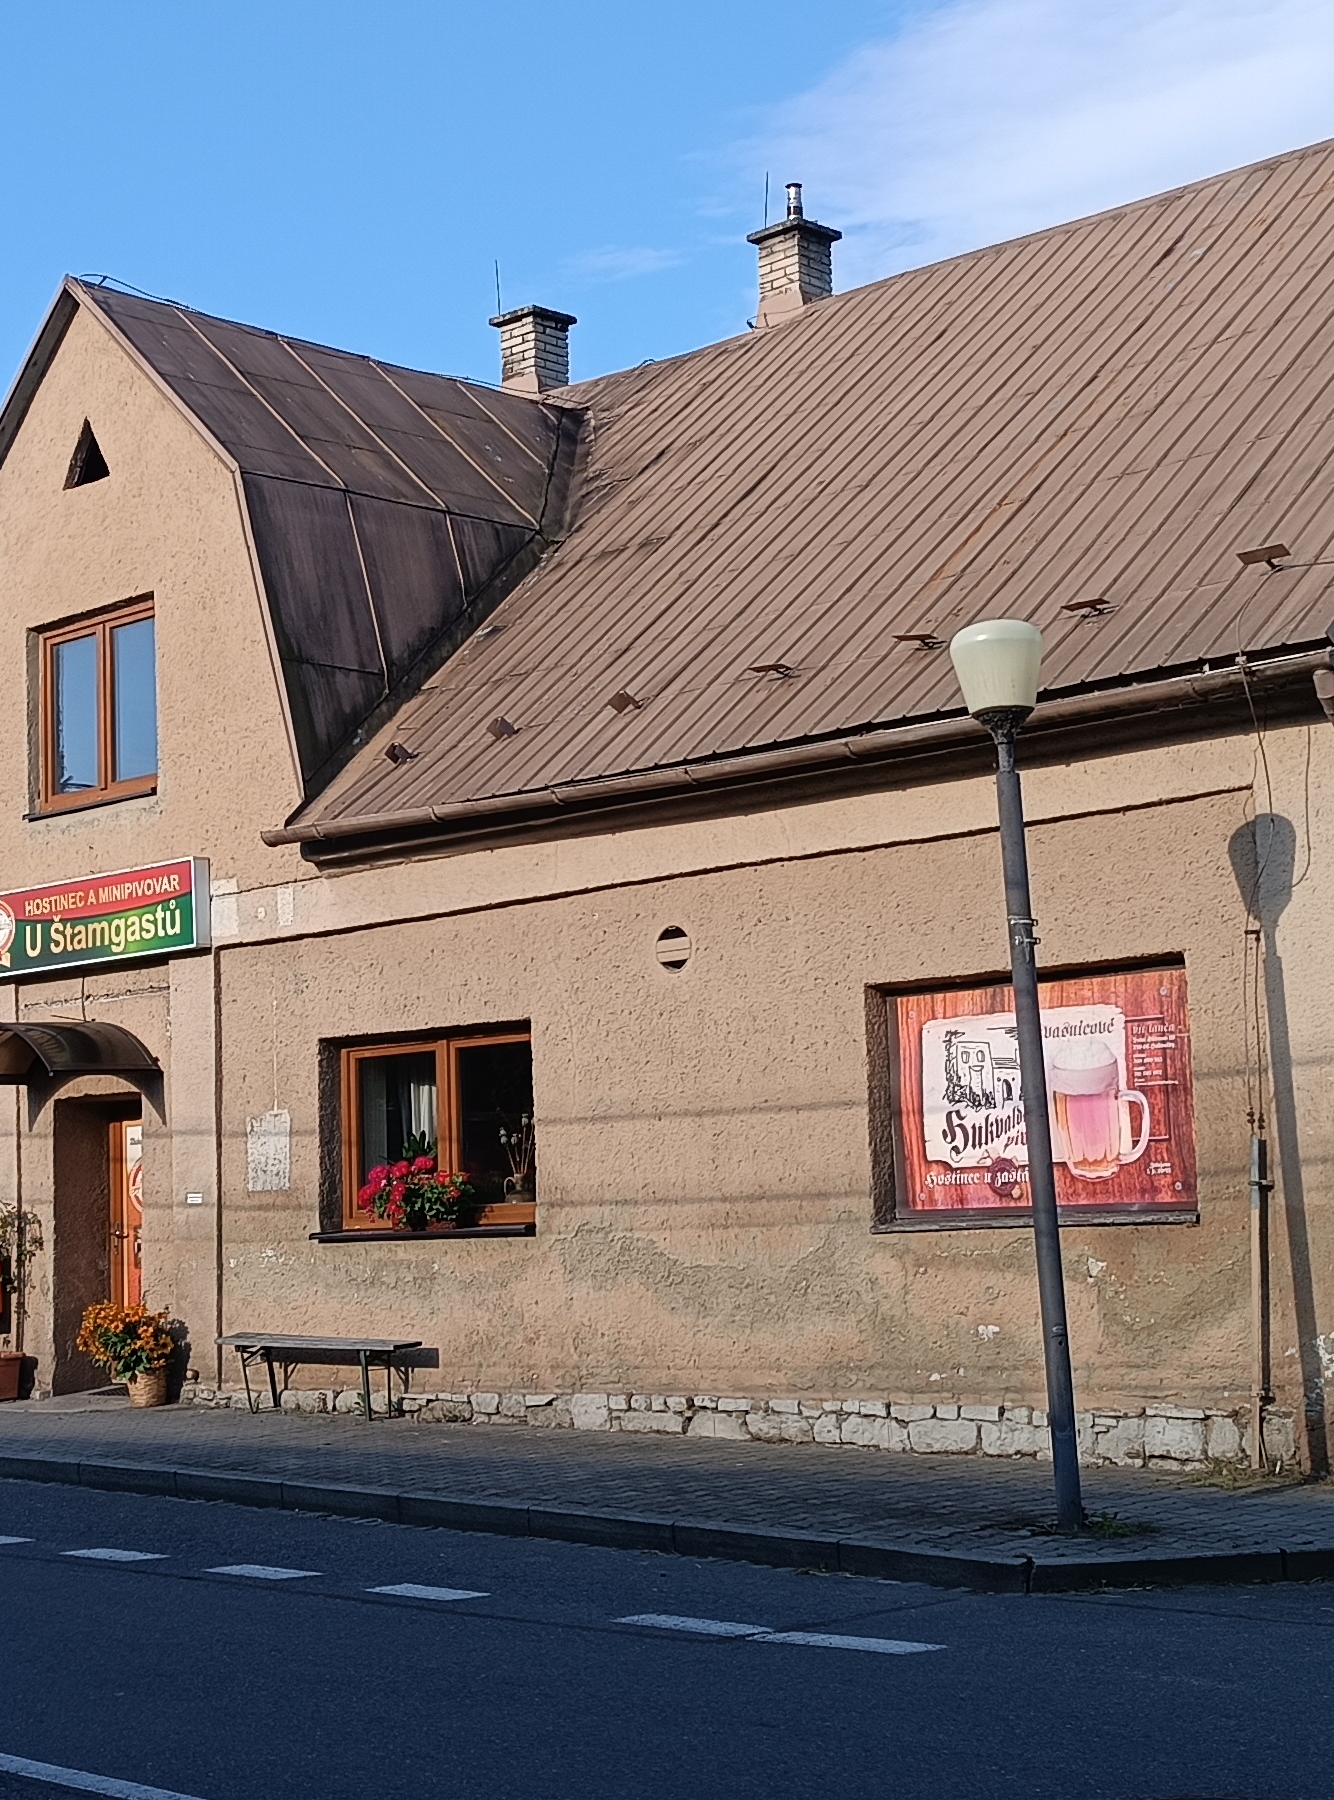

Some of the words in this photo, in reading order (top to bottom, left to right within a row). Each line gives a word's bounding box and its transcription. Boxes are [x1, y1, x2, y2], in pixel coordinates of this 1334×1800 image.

[24, 891, 85, 917] HOSTINEC
[87, 889, 97, 906] A
[98, 874, 180, 904] MINIPIVOVAR
[25, 924, 42, 957] U
[50, 900, 182, 954] Štamgastů
[1044, 1017, 1115, 1039] vasnicové
[941, 1105, 1026, 1163] Hukvald
[1003, 1128, 1028, 1154] piv
[924, 1169, 981, 1191] Hostinec
